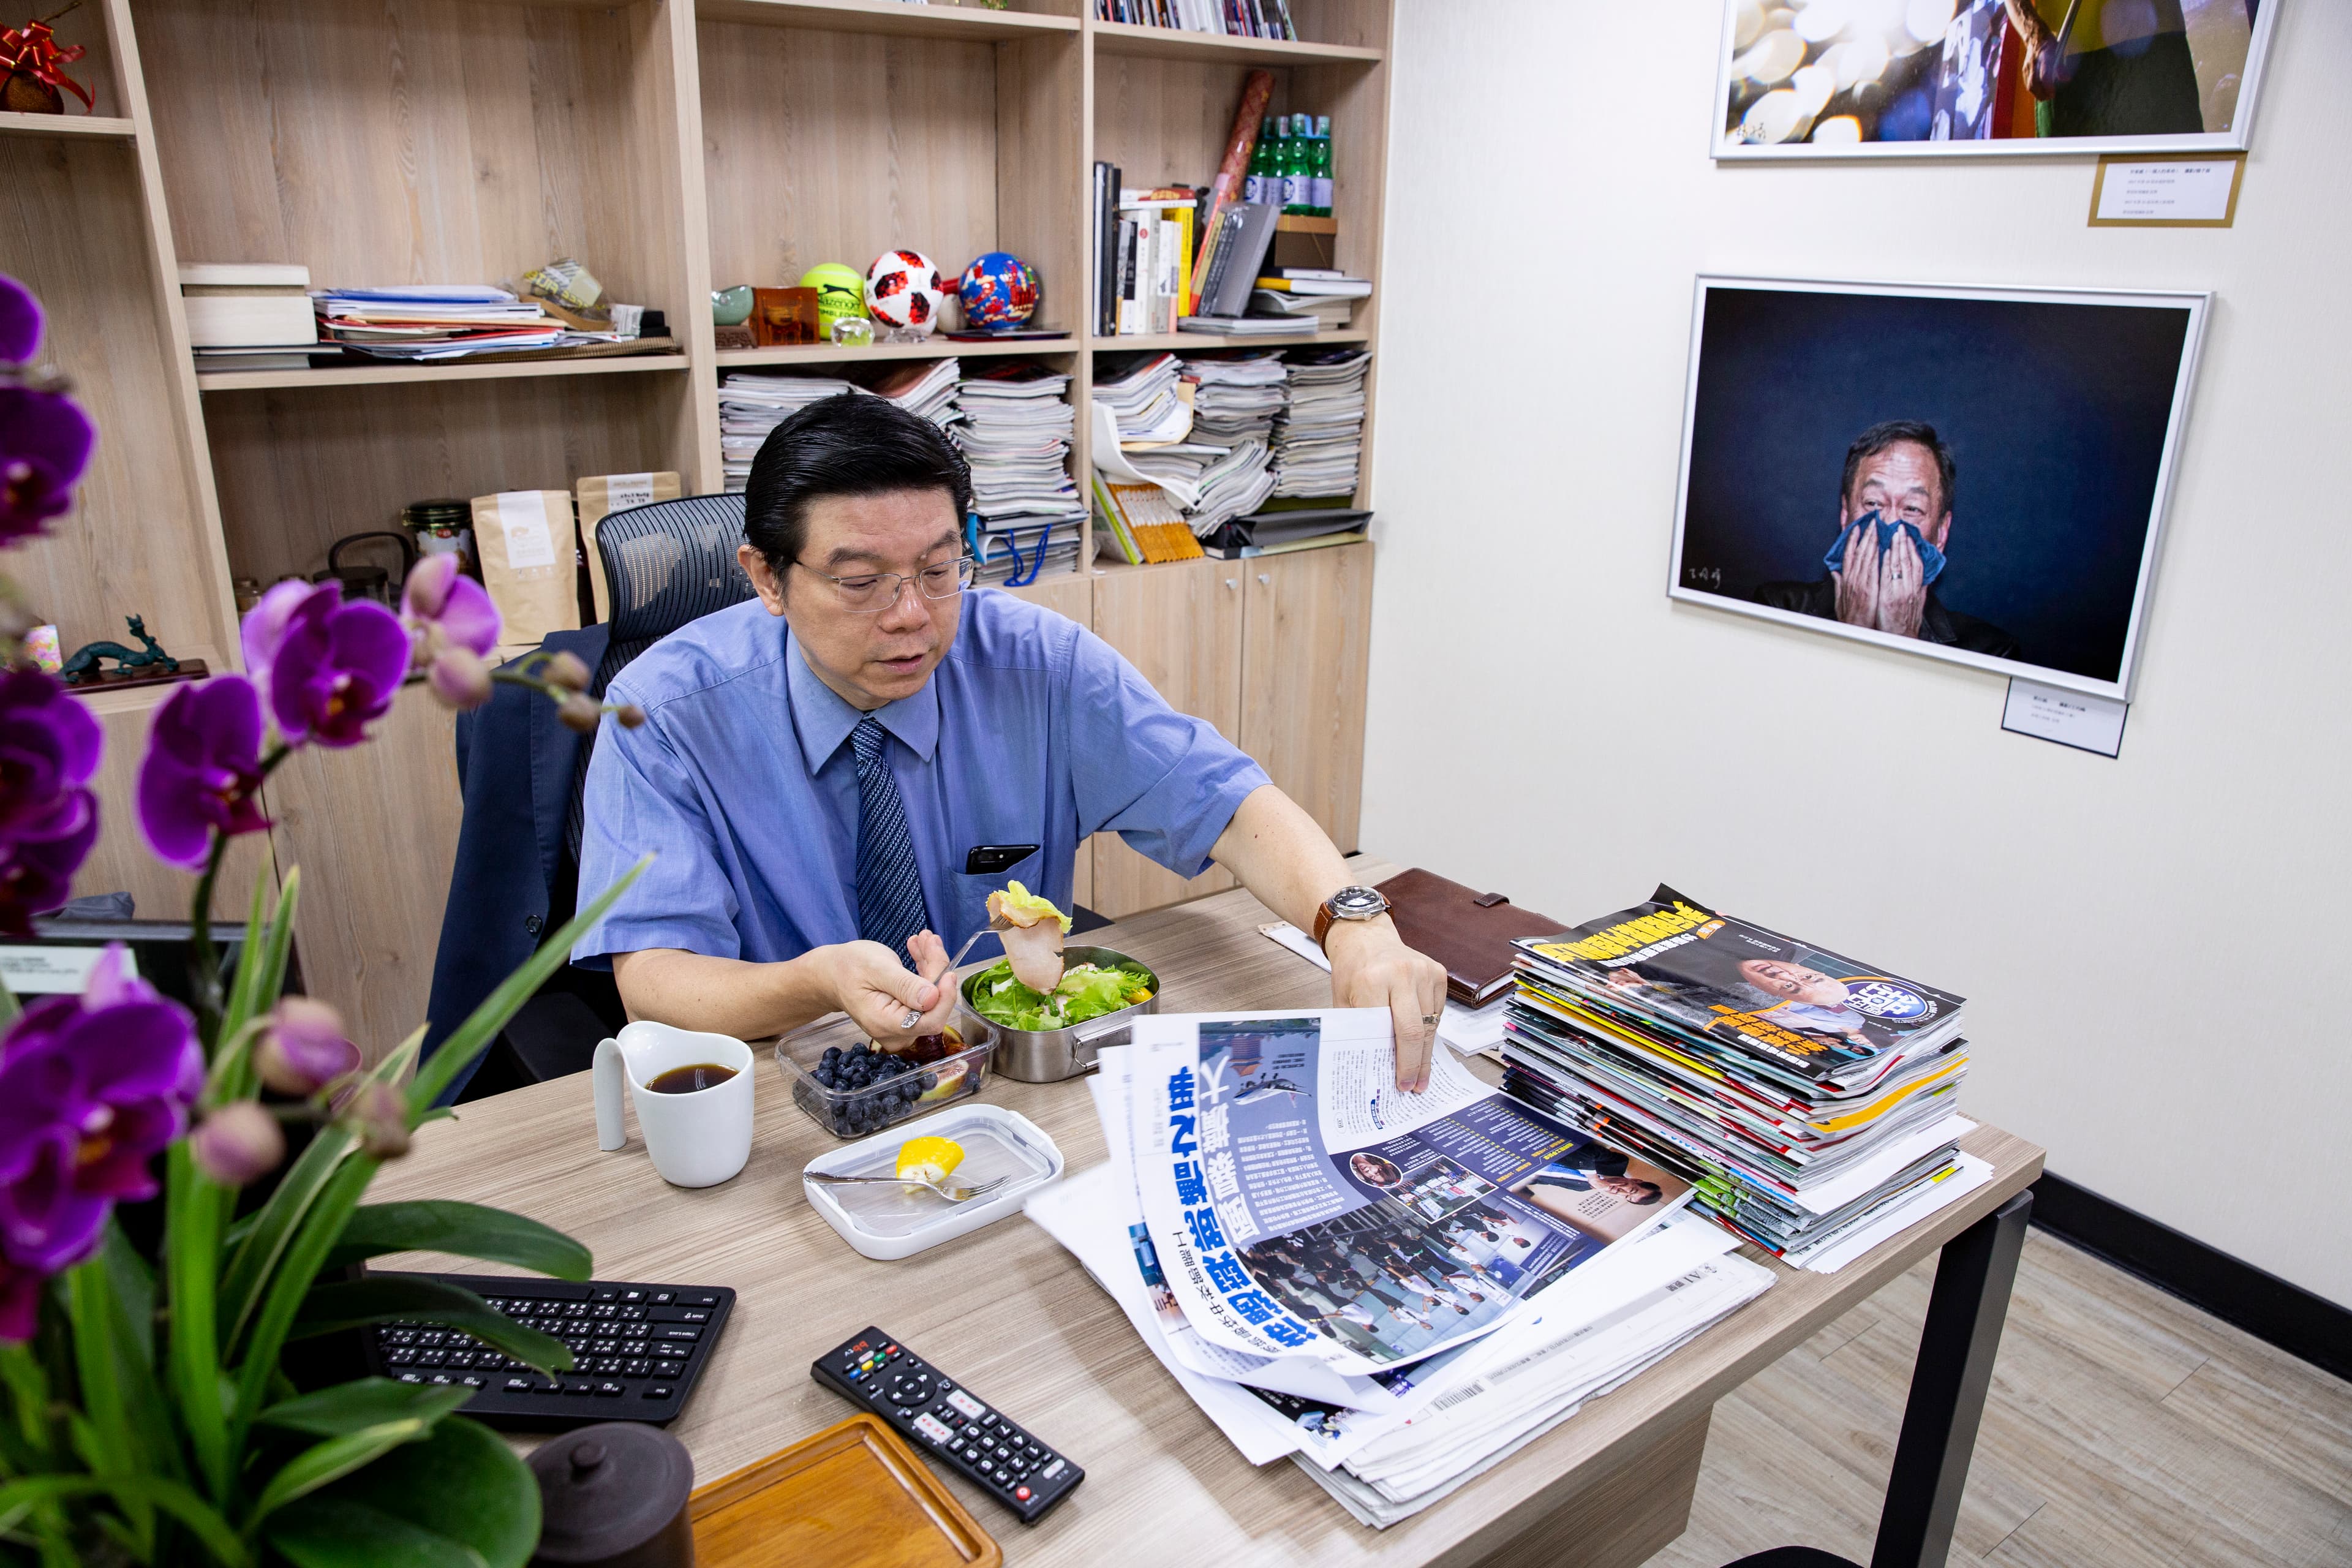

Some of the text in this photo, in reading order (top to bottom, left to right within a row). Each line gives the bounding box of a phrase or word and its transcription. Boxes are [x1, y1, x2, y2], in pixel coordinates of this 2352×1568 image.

[1199, 1055, 1261, 1245] 風暴擴大
[1169, 1067, 1315, 1346] 待遇與跳槽之爭
[968, 1427, 979, 1436] 0
[1000, 1425, 1011, 1435] 7
[982, 1437, 994, 1447] 8
[1014, 1435, 1023, 1445] 4
[967, 1449, 978, 1459] 9
[997, 1447, 1009, 1458] 5
[981, 1460, 993, 1470] 6
[1011, 1457, 1024, 1468] 2
[996, 1471, 1008, 1480] 3
